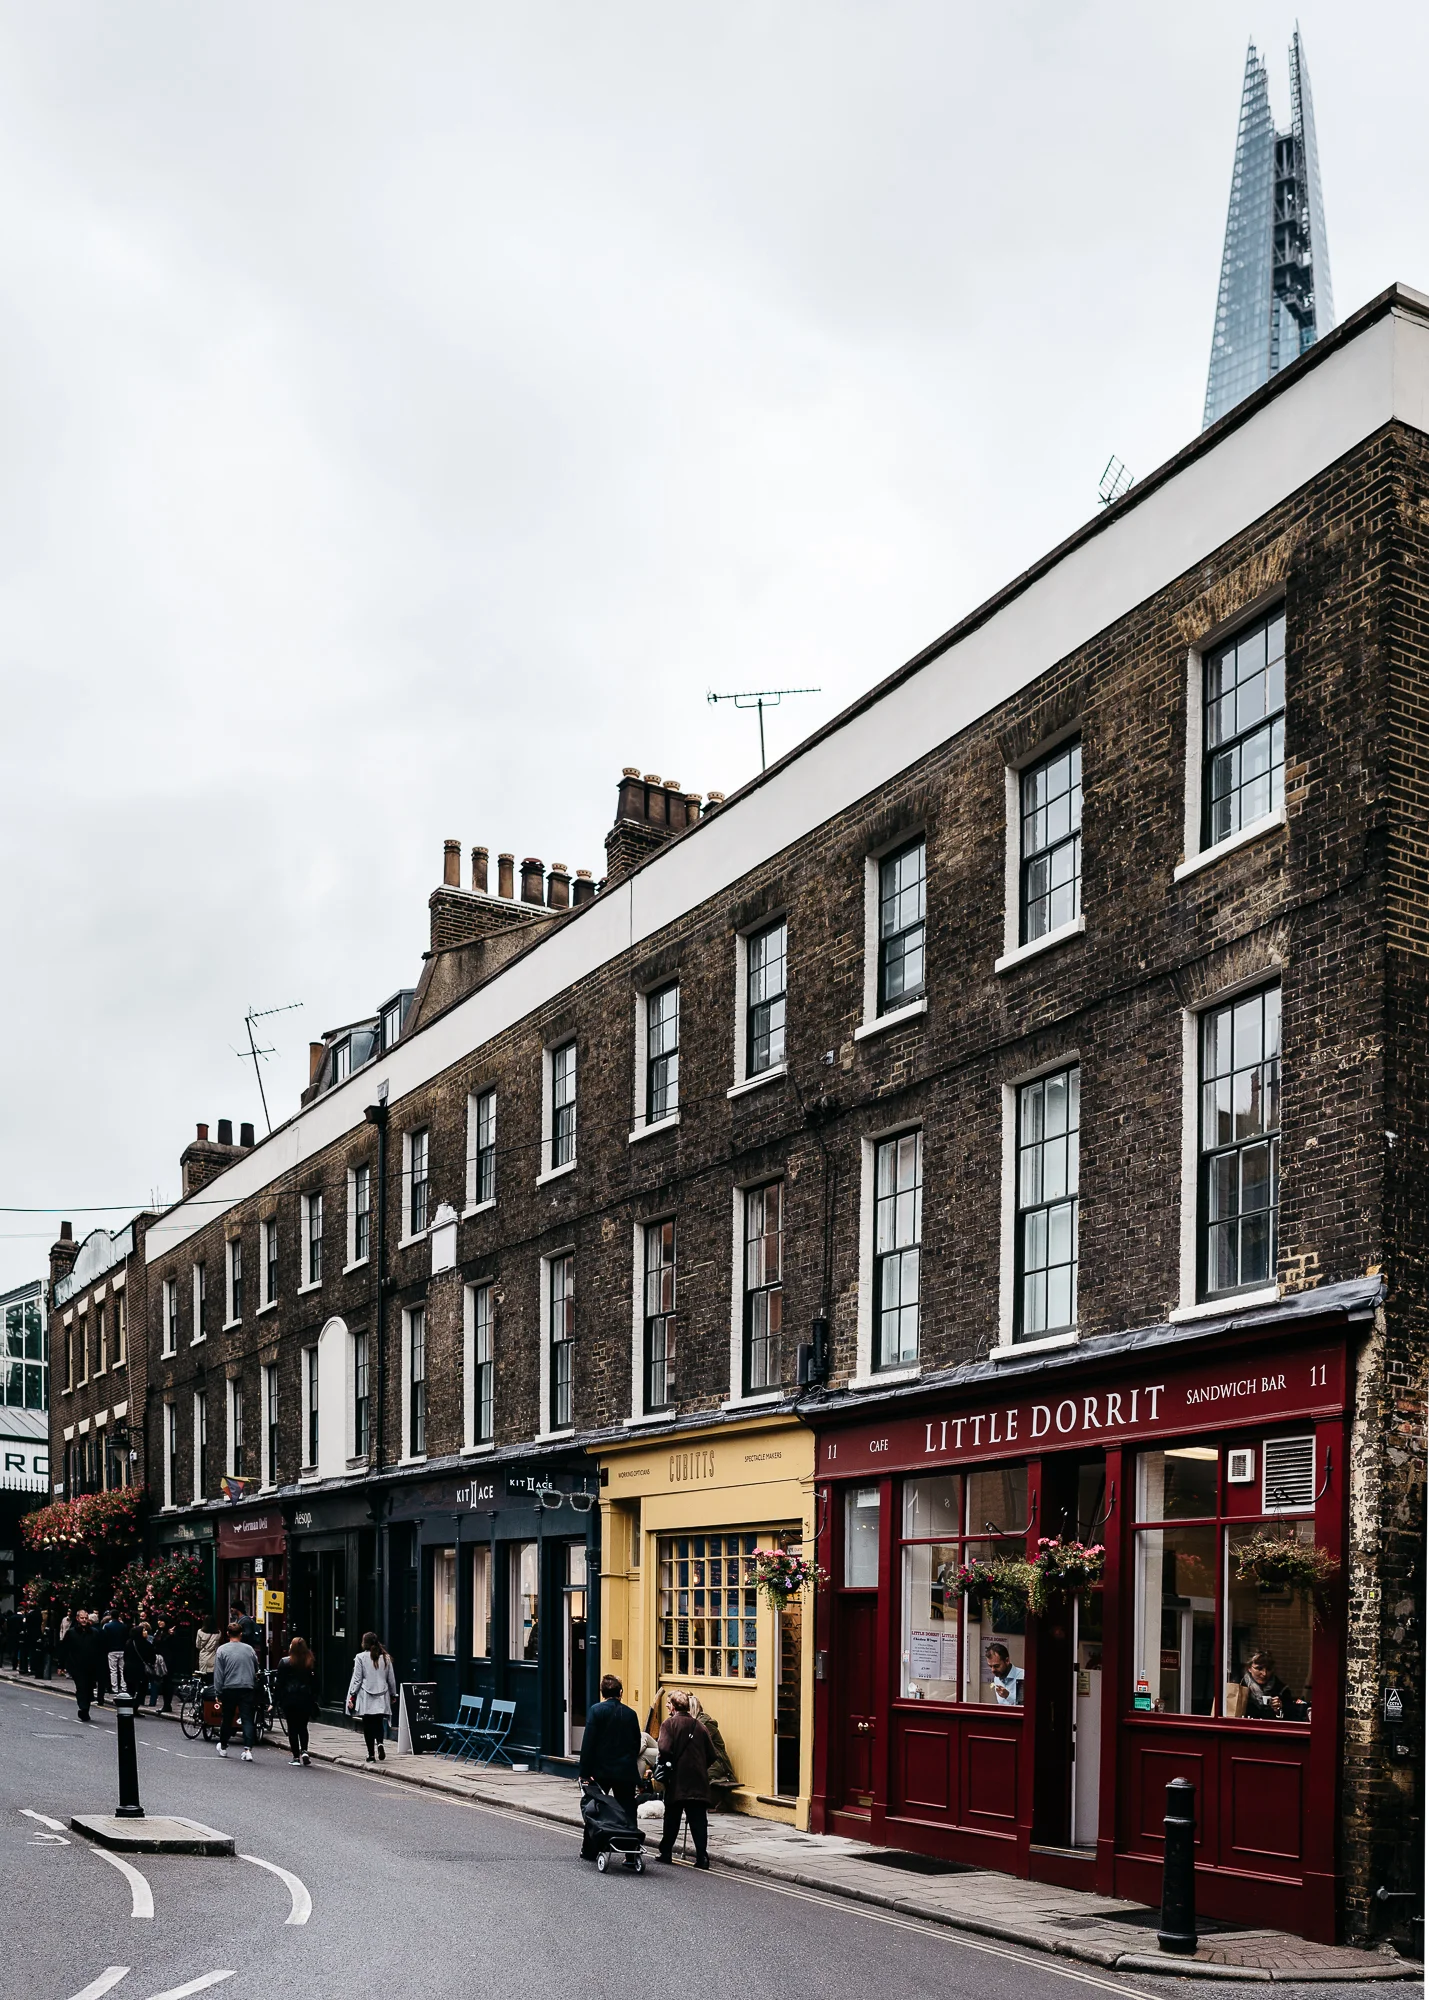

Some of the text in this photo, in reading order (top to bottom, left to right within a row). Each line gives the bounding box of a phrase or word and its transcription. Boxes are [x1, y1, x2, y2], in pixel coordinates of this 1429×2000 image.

[1309, 1364, 1328, 1387] 11
[1186, 1374, 1287, 1405] SANDWICH BAR
[924, 1384, 1165, 1454] LITTLE DORRIT
[827, 1444, 838, 1460] 11
[869, 1439, 889, 1453] CAFE
[744, 1451, 782, 1462] SPECTACLE MAKERS
[618, 1468, 650, 1478] WORKING OPTICIANS
[669, 1450, 715, 1482] CUBITTS
[509, 1479, 525, 1487] KIT
[456, 1485, 494, 1503] KIT ACE
[242, 1520, 259, 1532] German
[259, 1517, 268, 1530] Deli
